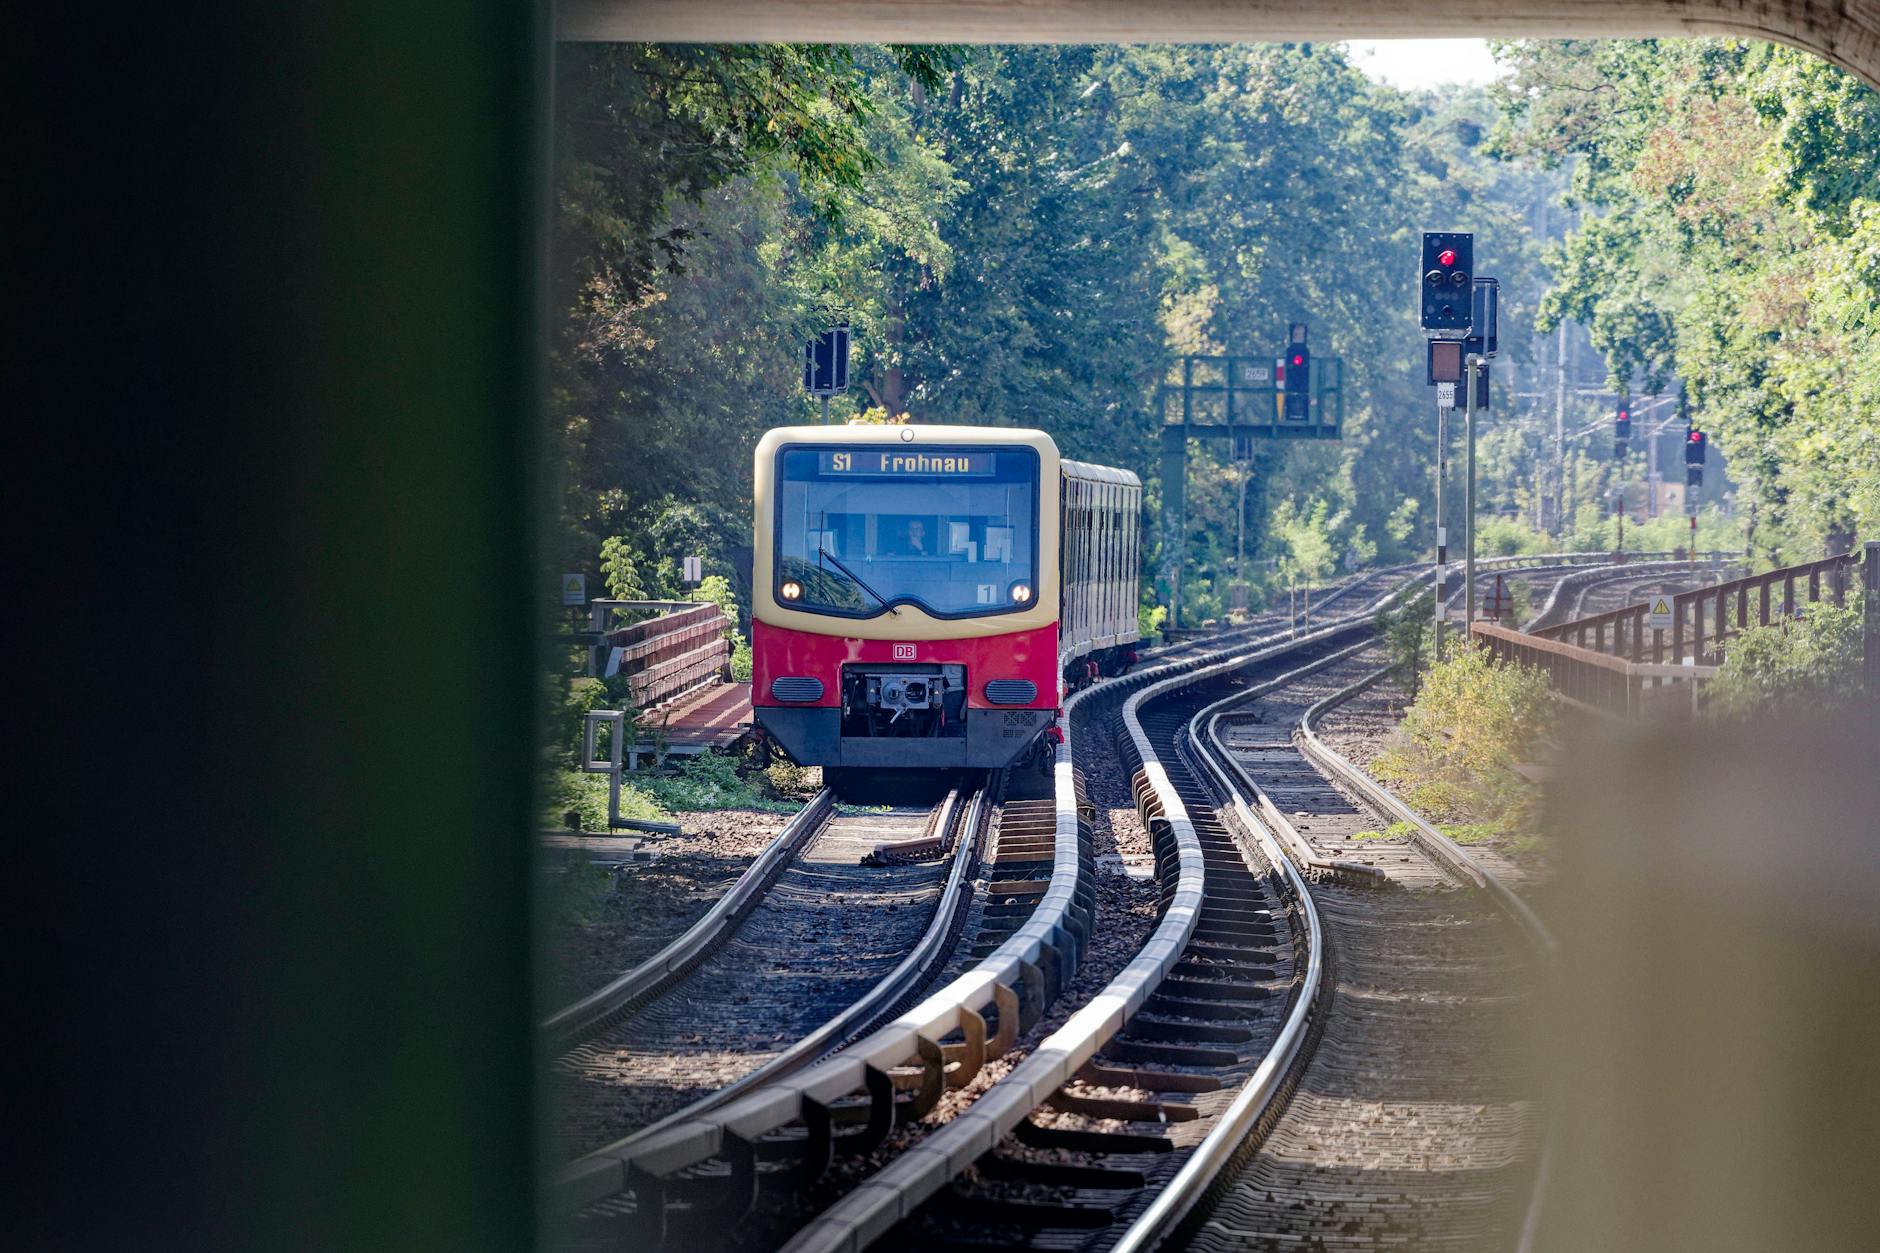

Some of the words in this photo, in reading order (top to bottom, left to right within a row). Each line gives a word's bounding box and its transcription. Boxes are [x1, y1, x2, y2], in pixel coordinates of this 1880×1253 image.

[1438, 390, 1454, 400] 2655
[832, 453, 851, 471] S1
[880, 453, 969, 472] Frohnau
[983, 585, 991, 602] 1
[896, 646, 914, 658] DB
